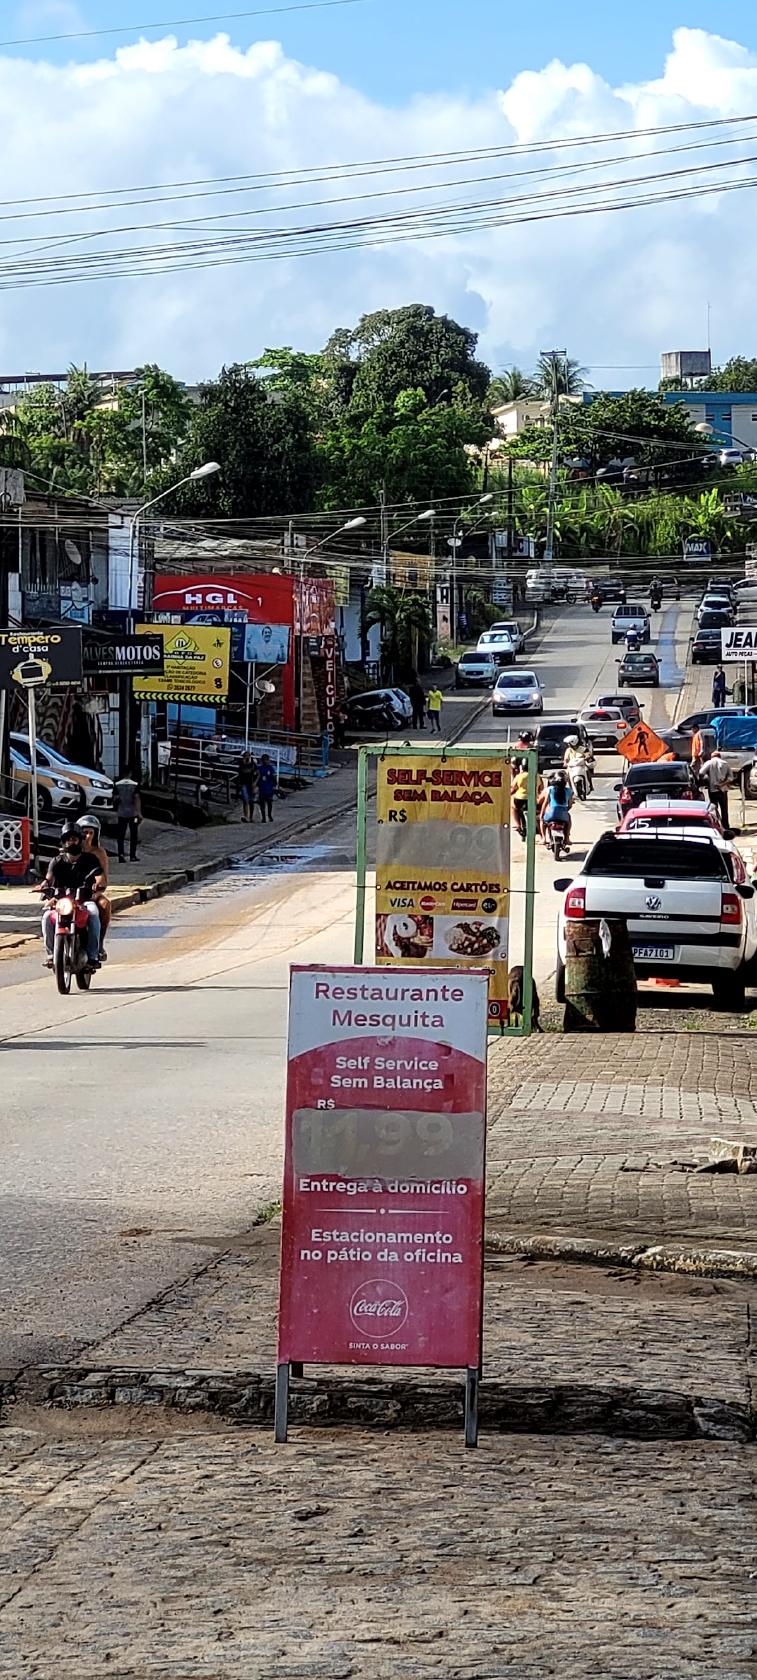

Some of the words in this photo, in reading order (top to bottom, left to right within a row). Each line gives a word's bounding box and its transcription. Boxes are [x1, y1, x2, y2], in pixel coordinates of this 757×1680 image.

[185, 593, 238, 604] HGL
[0, 634, 61, 646] Tempero
[725, 632, 757, 648] JEA
[12, 645, 49, 653] d'casa
[325, 648, 335, 744] VEICULOS
[387, 768, 502, 787] SELF-SERVICE
[393, 789, 428, 801] SEM
[430, 790, 494, 806] BALAÇA
[388, 808, 408, 822] R$
[385, 880, 448, 892] ACEITAMOS
[450, 881, 501, 893] CARTÕES
[390, 898, 415, 908] VISA
[314, 982, 464, 1002] Restaurante
[332, 1009, 445, 1031] Mesquita
[335, 1056, 370, 1070] Self
[374, 1056, 439, 1071] Service
[330, 1075, 368, 1088] Sem
[373, 1075, 444, 1092] Balança
[317, 1098, 336, 1110] R$
[299, 1178, 369, 1195] Entrega
[387, 1180, 468, 1195] domicílio
[310, 1229, 453, 1244] Estacionamento
[300, 1249, 322, 1261] no
[327, 1247, 372, 1264] pátio
[376, 1248, 398, 1262] da
[403, 1248, 463, 1263] oficina
